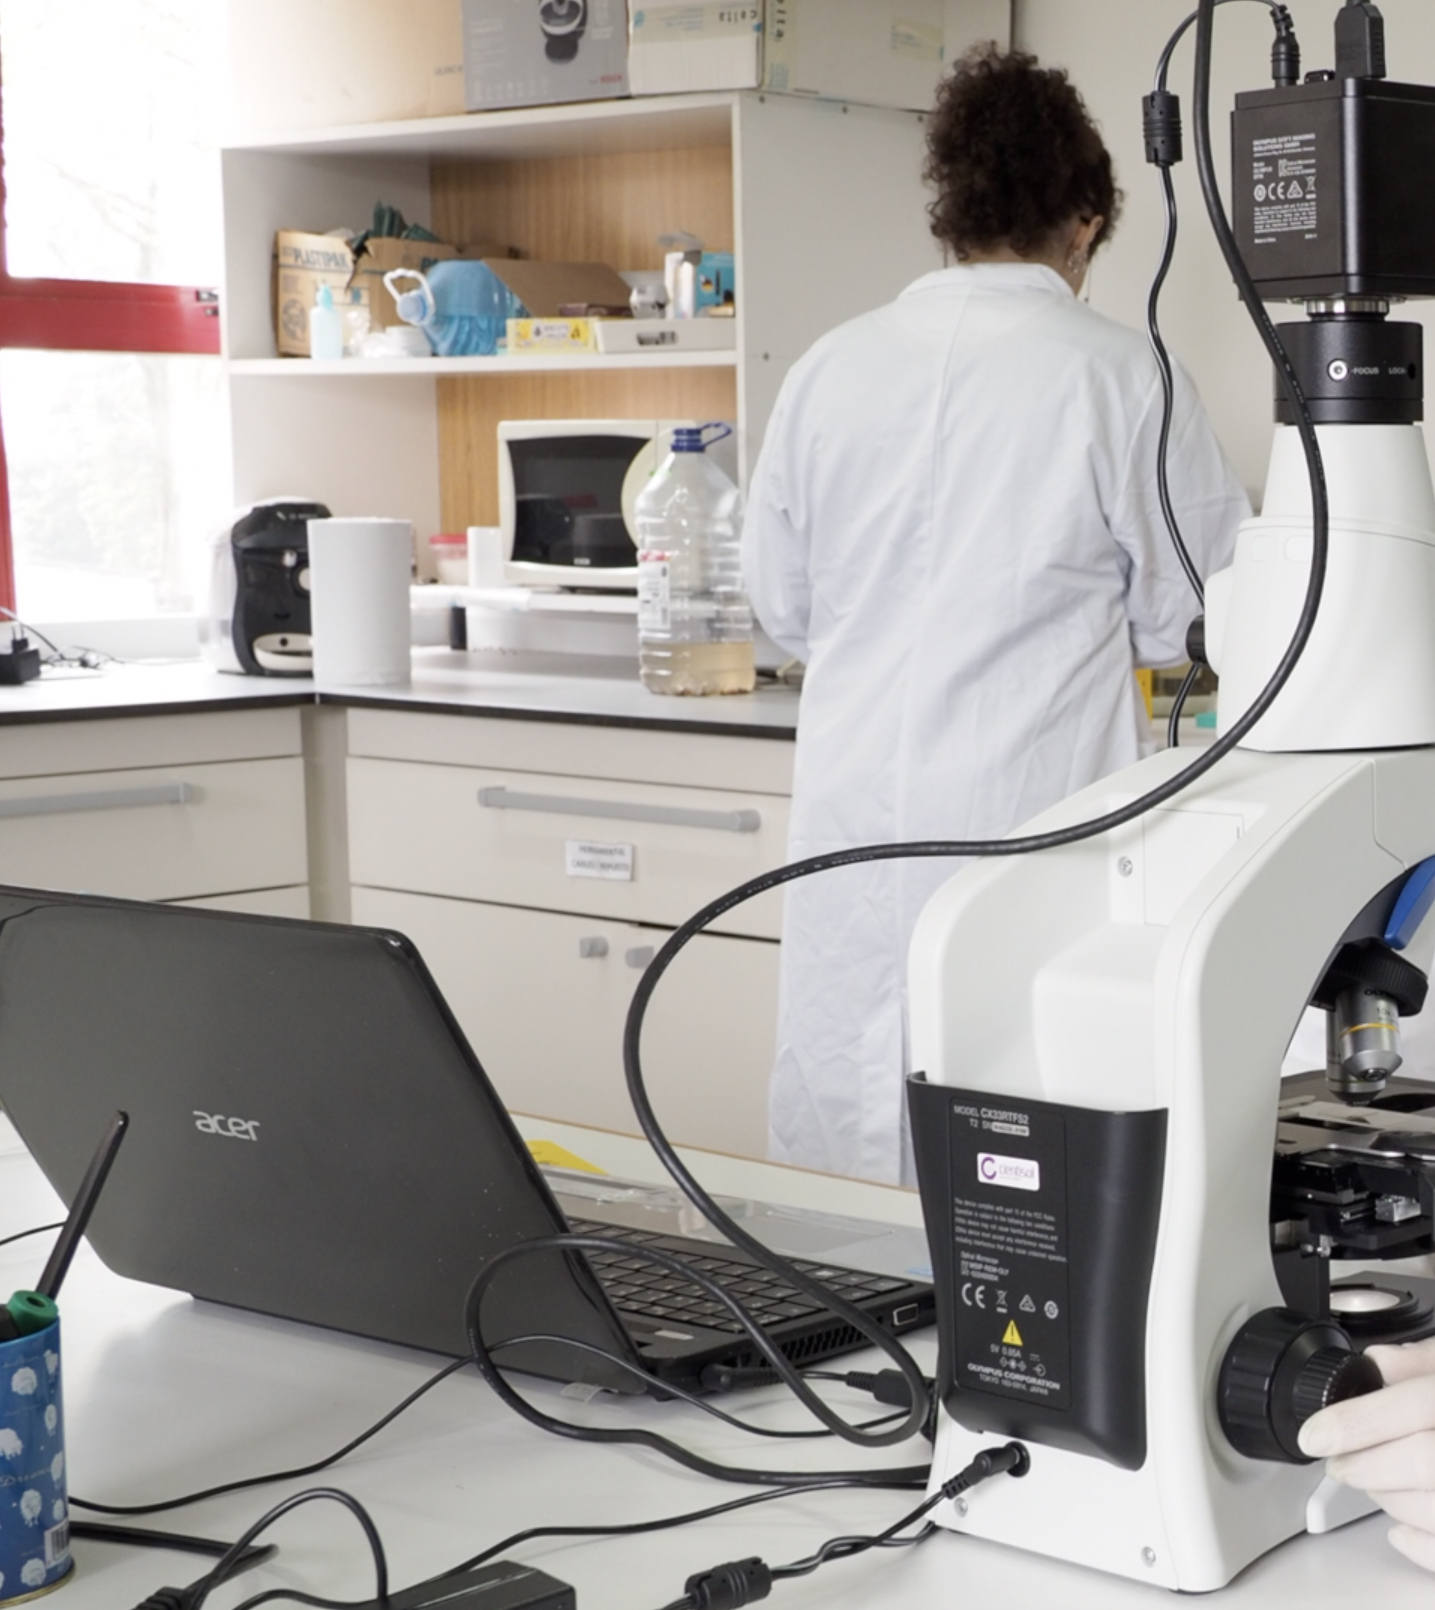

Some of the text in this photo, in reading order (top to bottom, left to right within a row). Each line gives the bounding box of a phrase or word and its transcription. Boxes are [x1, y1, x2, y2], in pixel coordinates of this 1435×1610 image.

[192, 1110, 260, 1141] acer
[953, 1104, 980, 1117] MODEL
[967, 1361, 1061, 1391] OLYMPUS CORPORATION
